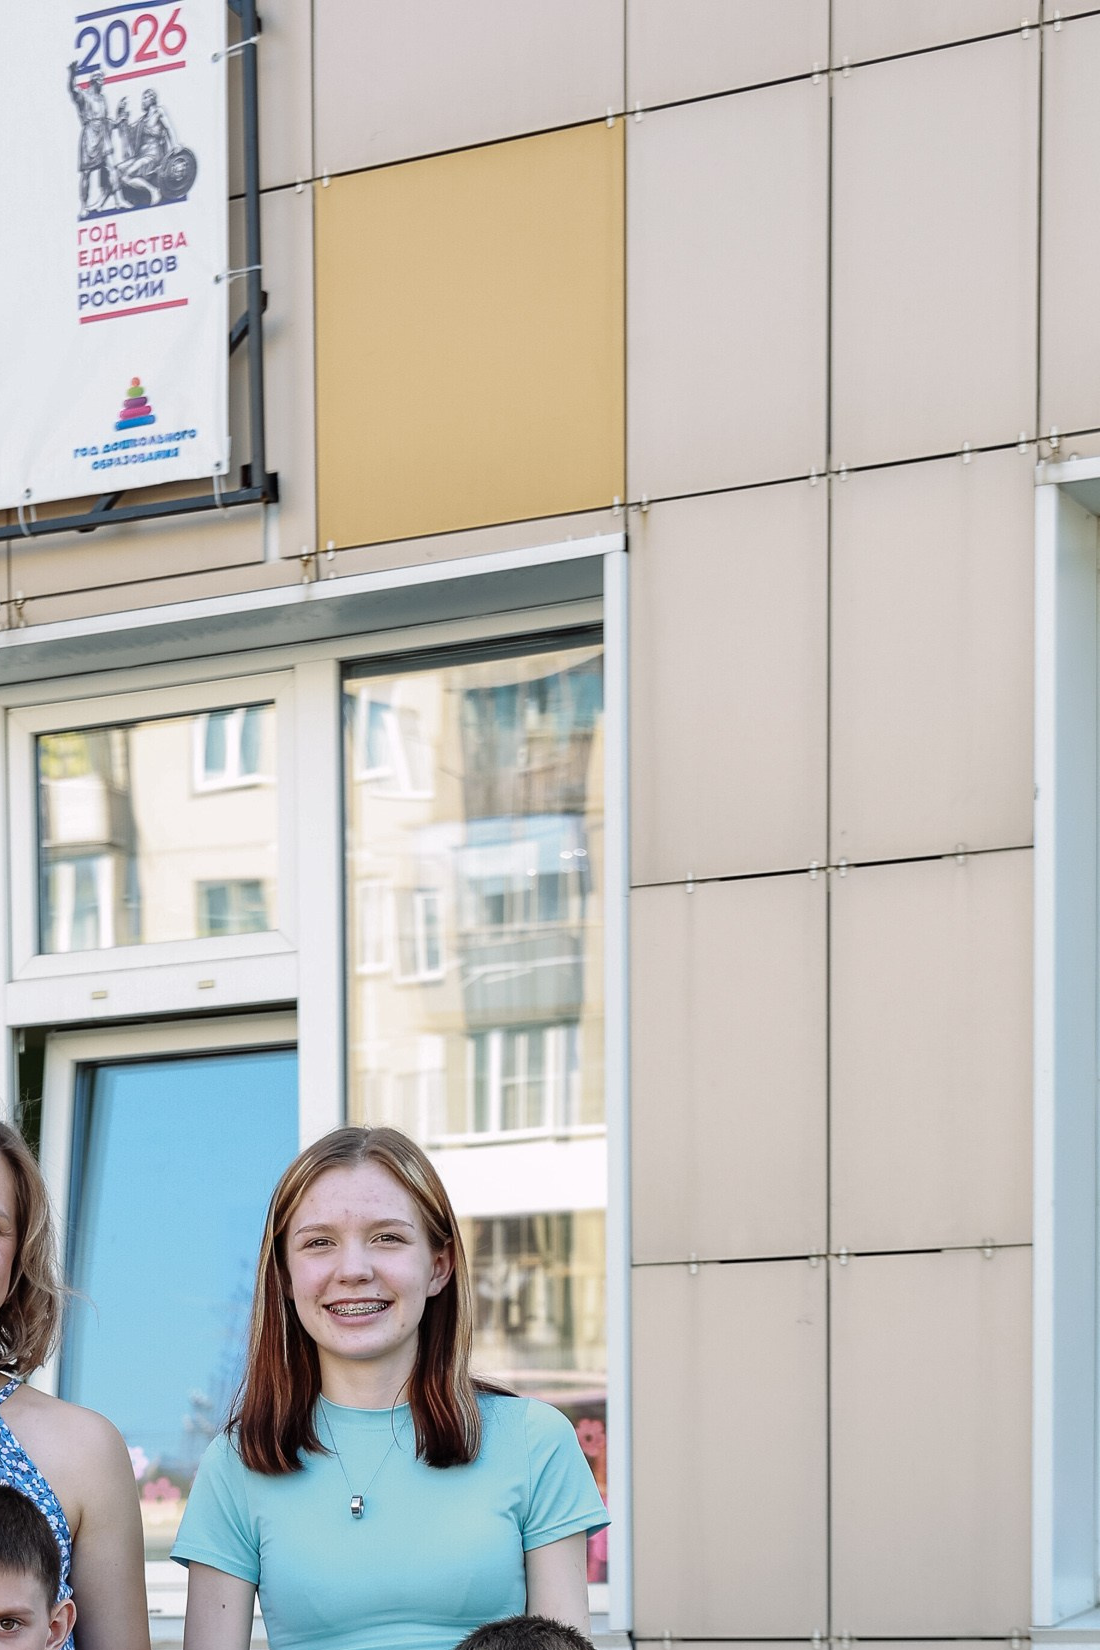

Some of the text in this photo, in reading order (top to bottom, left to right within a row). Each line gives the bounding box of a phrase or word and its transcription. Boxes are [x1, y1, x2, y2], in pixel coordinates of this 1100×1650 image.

[75, 8, 188, 76] 2026
[78, 223, 118, 246] ГОД
[78, 231, 188, 267] ЕДИНСТВА
[78, 255, 178, 289] НАРОДОВ
[78, 279, 165, 310] РОССИИ
[74, 446, 98, 458] ГОД
